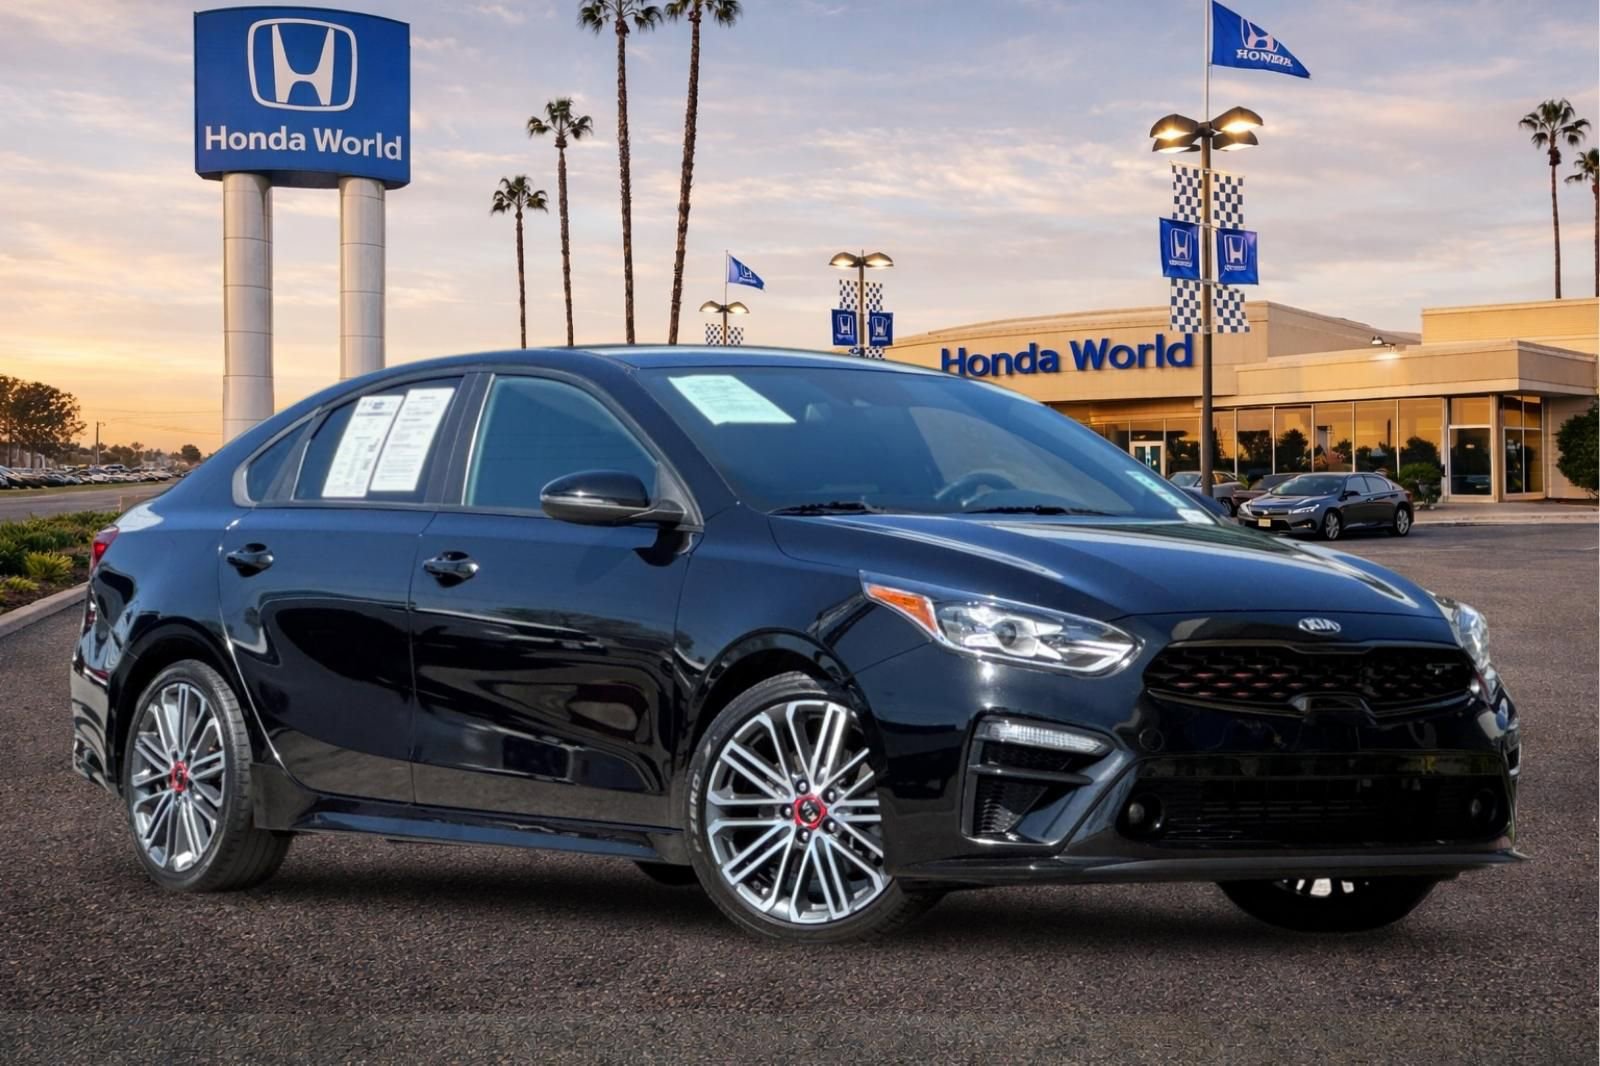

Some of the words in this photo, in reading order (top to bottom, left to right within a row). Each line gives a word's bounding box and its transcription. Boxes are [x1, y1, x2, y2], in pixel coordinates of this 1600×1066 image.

[205, 125, 306, 151] Honda
[312, 127, 402, 161] World
[941, 342, 1061, 377] Honda
[1069, 333, 1195, 371] World
[1302, 618, 1338, 631] KIA
